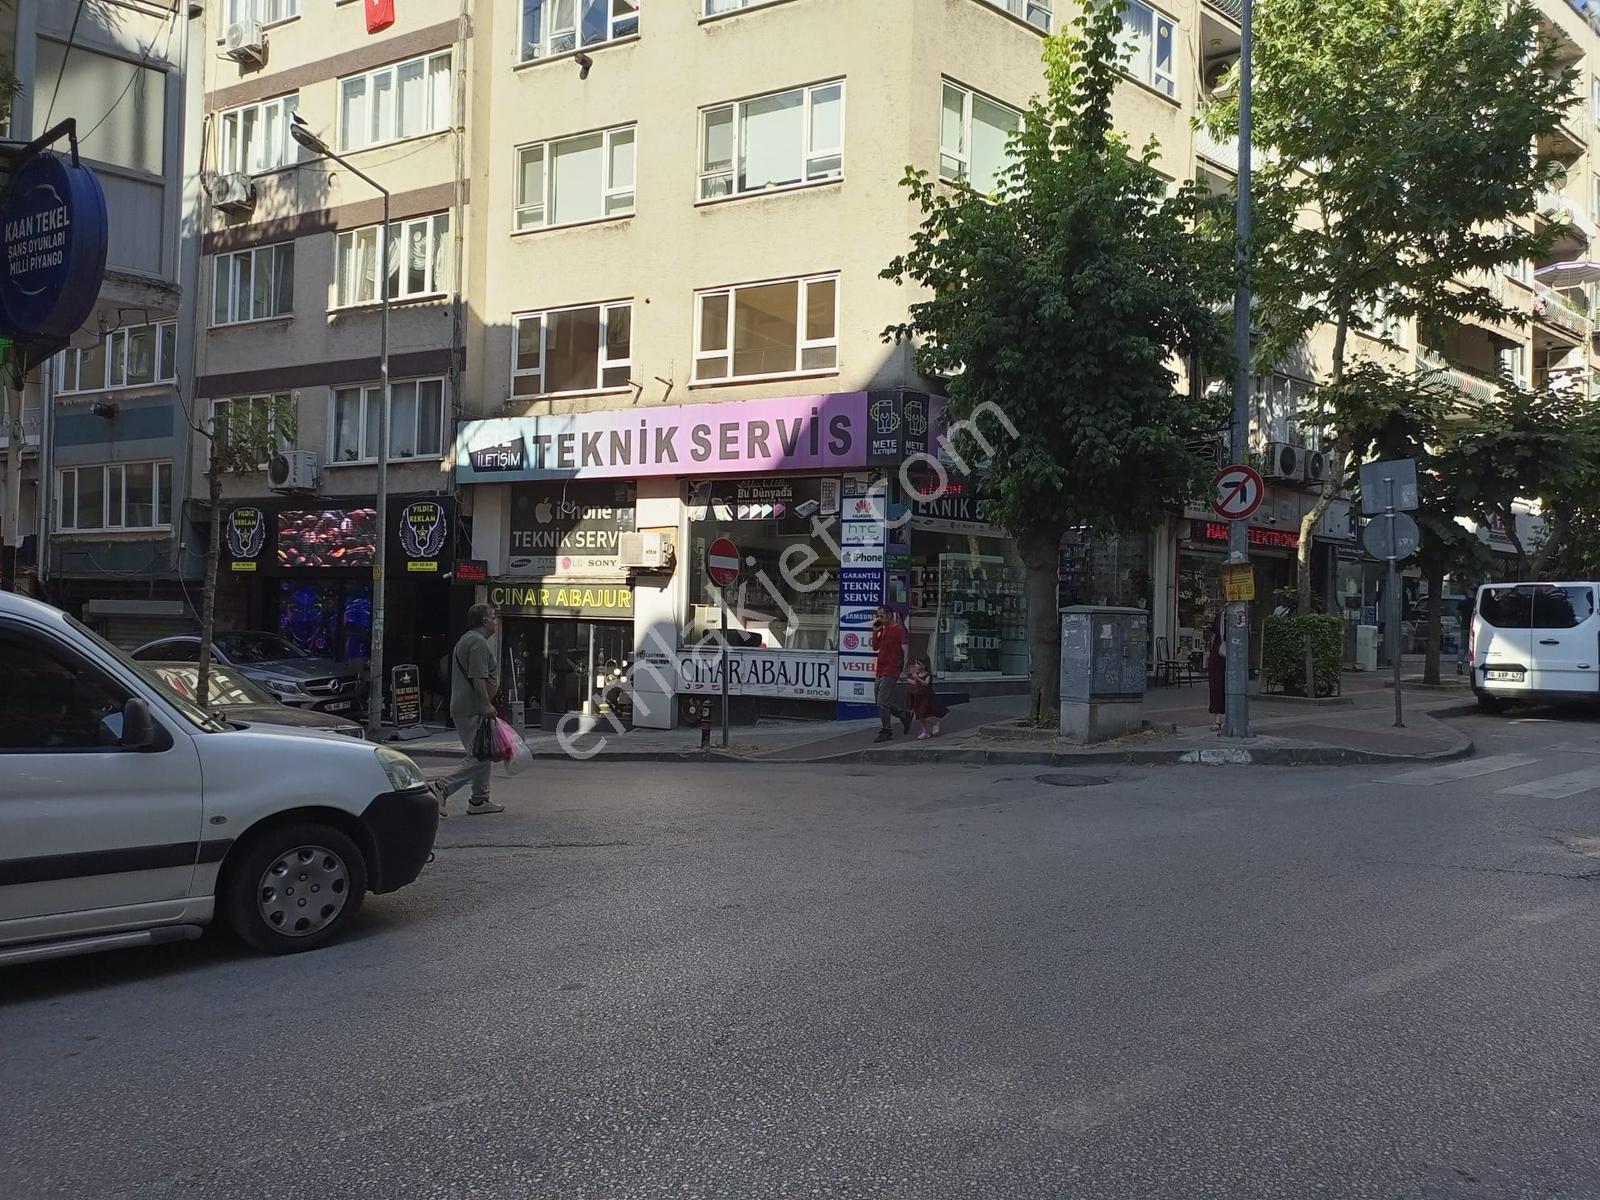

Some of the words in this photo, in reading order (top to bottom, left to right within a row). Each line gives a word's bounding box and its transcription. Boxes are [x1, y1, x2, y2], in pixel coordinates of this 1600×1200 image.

[5, 216, 33, 243] KAAN
[36, 205, 70, 233] TEKEL
[8, 241, 28, 262] ŞANS
[28, 231, 66, 253] OYUNLARI
[10, 254, 29, 276] MİLLİ
[30, 250, 63, 271] PİYANGO
[532, 419, 679, 469] TEKNİK
[690, 406, 852, 461] SERVİS
[872, 439, 897, 448] METE
[905, 440, 925, 451] METE
[477, 450, 521, 470] İLETİŞİM
[737, 488, 750, 498] Bu
[752, 487, 793, 499] Dünyada
[409, 515, 436, 523] REKLAM
[556, 499, 612, 520] iPhone
[513, 527, 572, 548] TEKNİK
[575, 527, 634, 548] SERV
[853, 552, 883, 562] iPhone
[842, 571, 881, 579] GARANTİLİ
[842, 581, 881, 591] TEKNİK
[491, 587, 549, 610] ÇINAR
[555, 588, 632, 608] ABAJUR
[843, 592, 880, 602] SERVİS
[746, 659, 831, 688] ABAJUR
